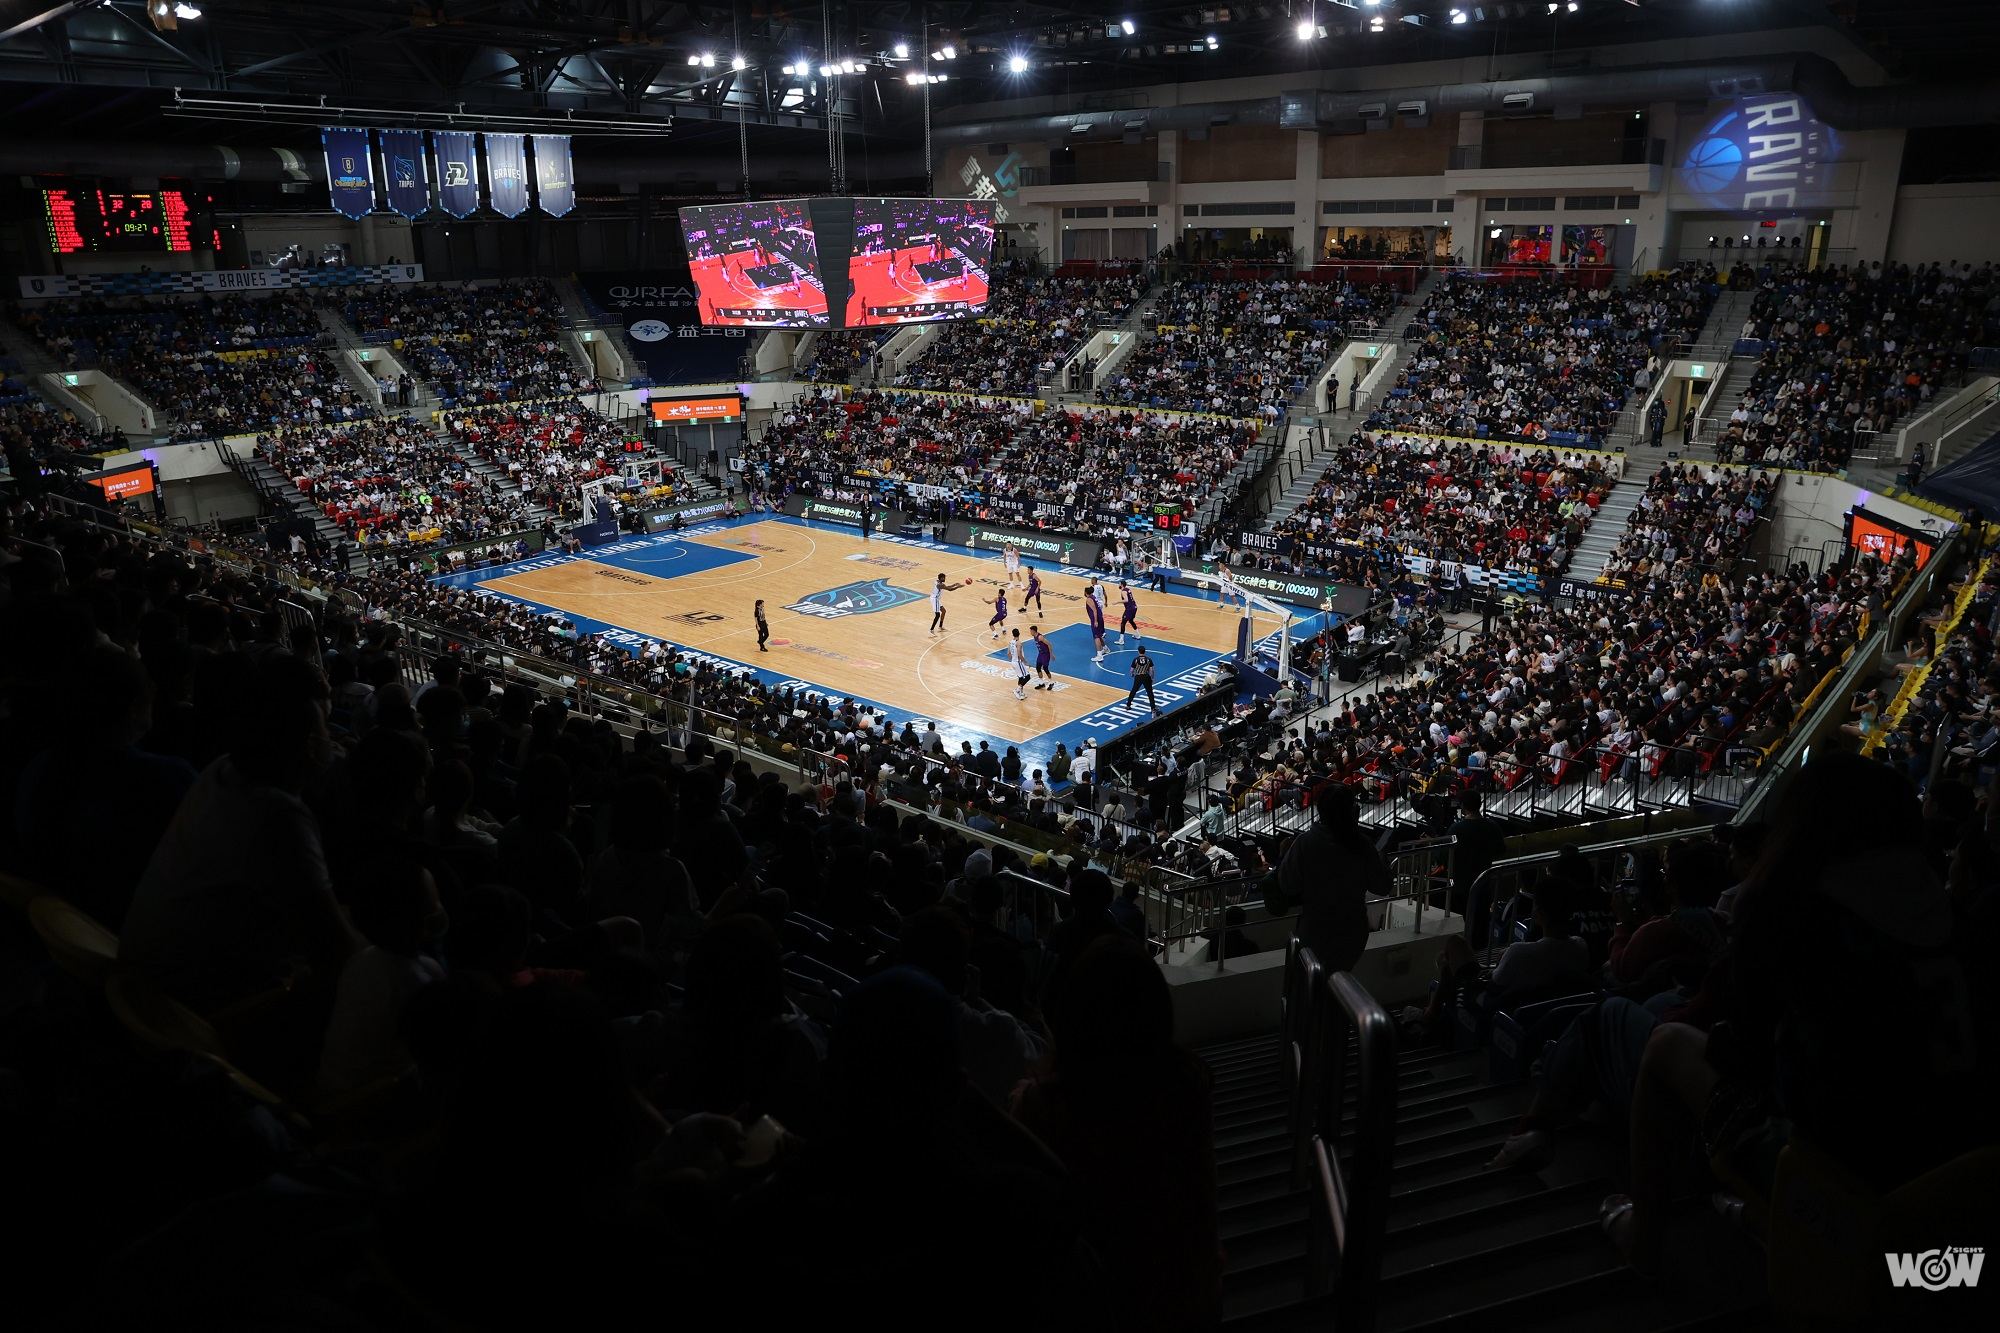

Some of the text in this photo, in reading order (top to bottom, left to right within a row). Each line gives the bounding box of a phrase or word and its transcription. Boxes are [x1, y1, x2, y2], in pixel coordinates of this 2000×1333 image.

[494, 168, 521, 180] BRAVES
[112, 199, 124, 209] 32
[141, 200, 152, 209] 28
[124, 223, 147, 232] 09:27
[218, 272, 267, 288] BRAVES
[1036, 502, 1066, 517] BRAVES
[1158, 515, 1169, 529] 19
[1034, 539, 1060, 553] (00920)
[1242, 532, 1278, 550] BRAVES
[1285, 582, 1319, 599] (00920)
[784, 601, 853, 618] TAIPEI
